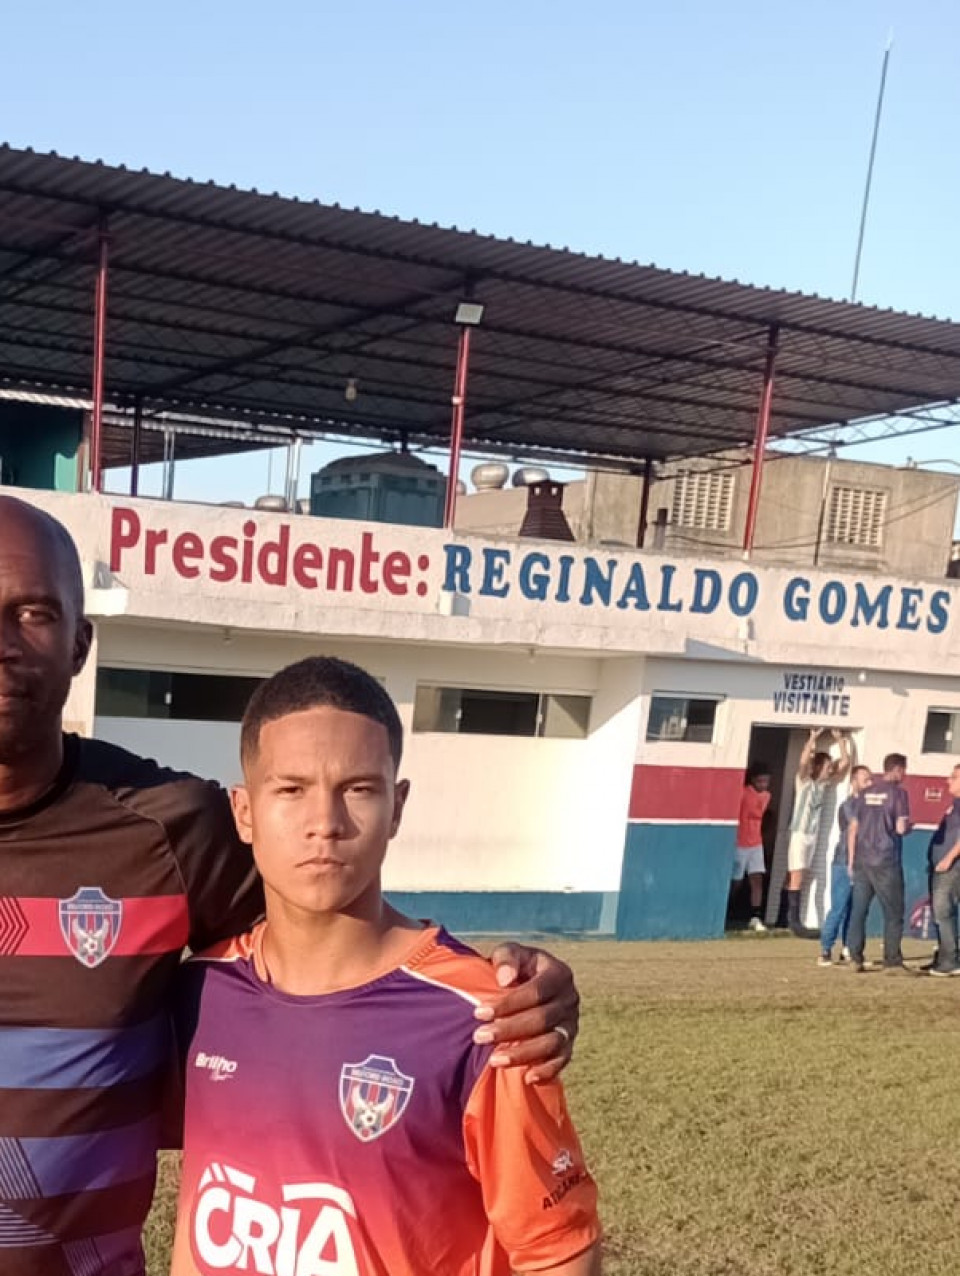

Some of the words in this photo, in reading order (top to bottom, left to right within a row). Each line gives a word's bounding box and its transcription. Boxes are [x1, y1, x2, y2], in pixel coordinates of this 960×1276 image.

[110, 506, 430, 597] Presidente:
[442, 544, 760, 617] REGINALDO
[783, 576, 951, 634] GOMES
[774, 691, 851, 716] VISITANTE
